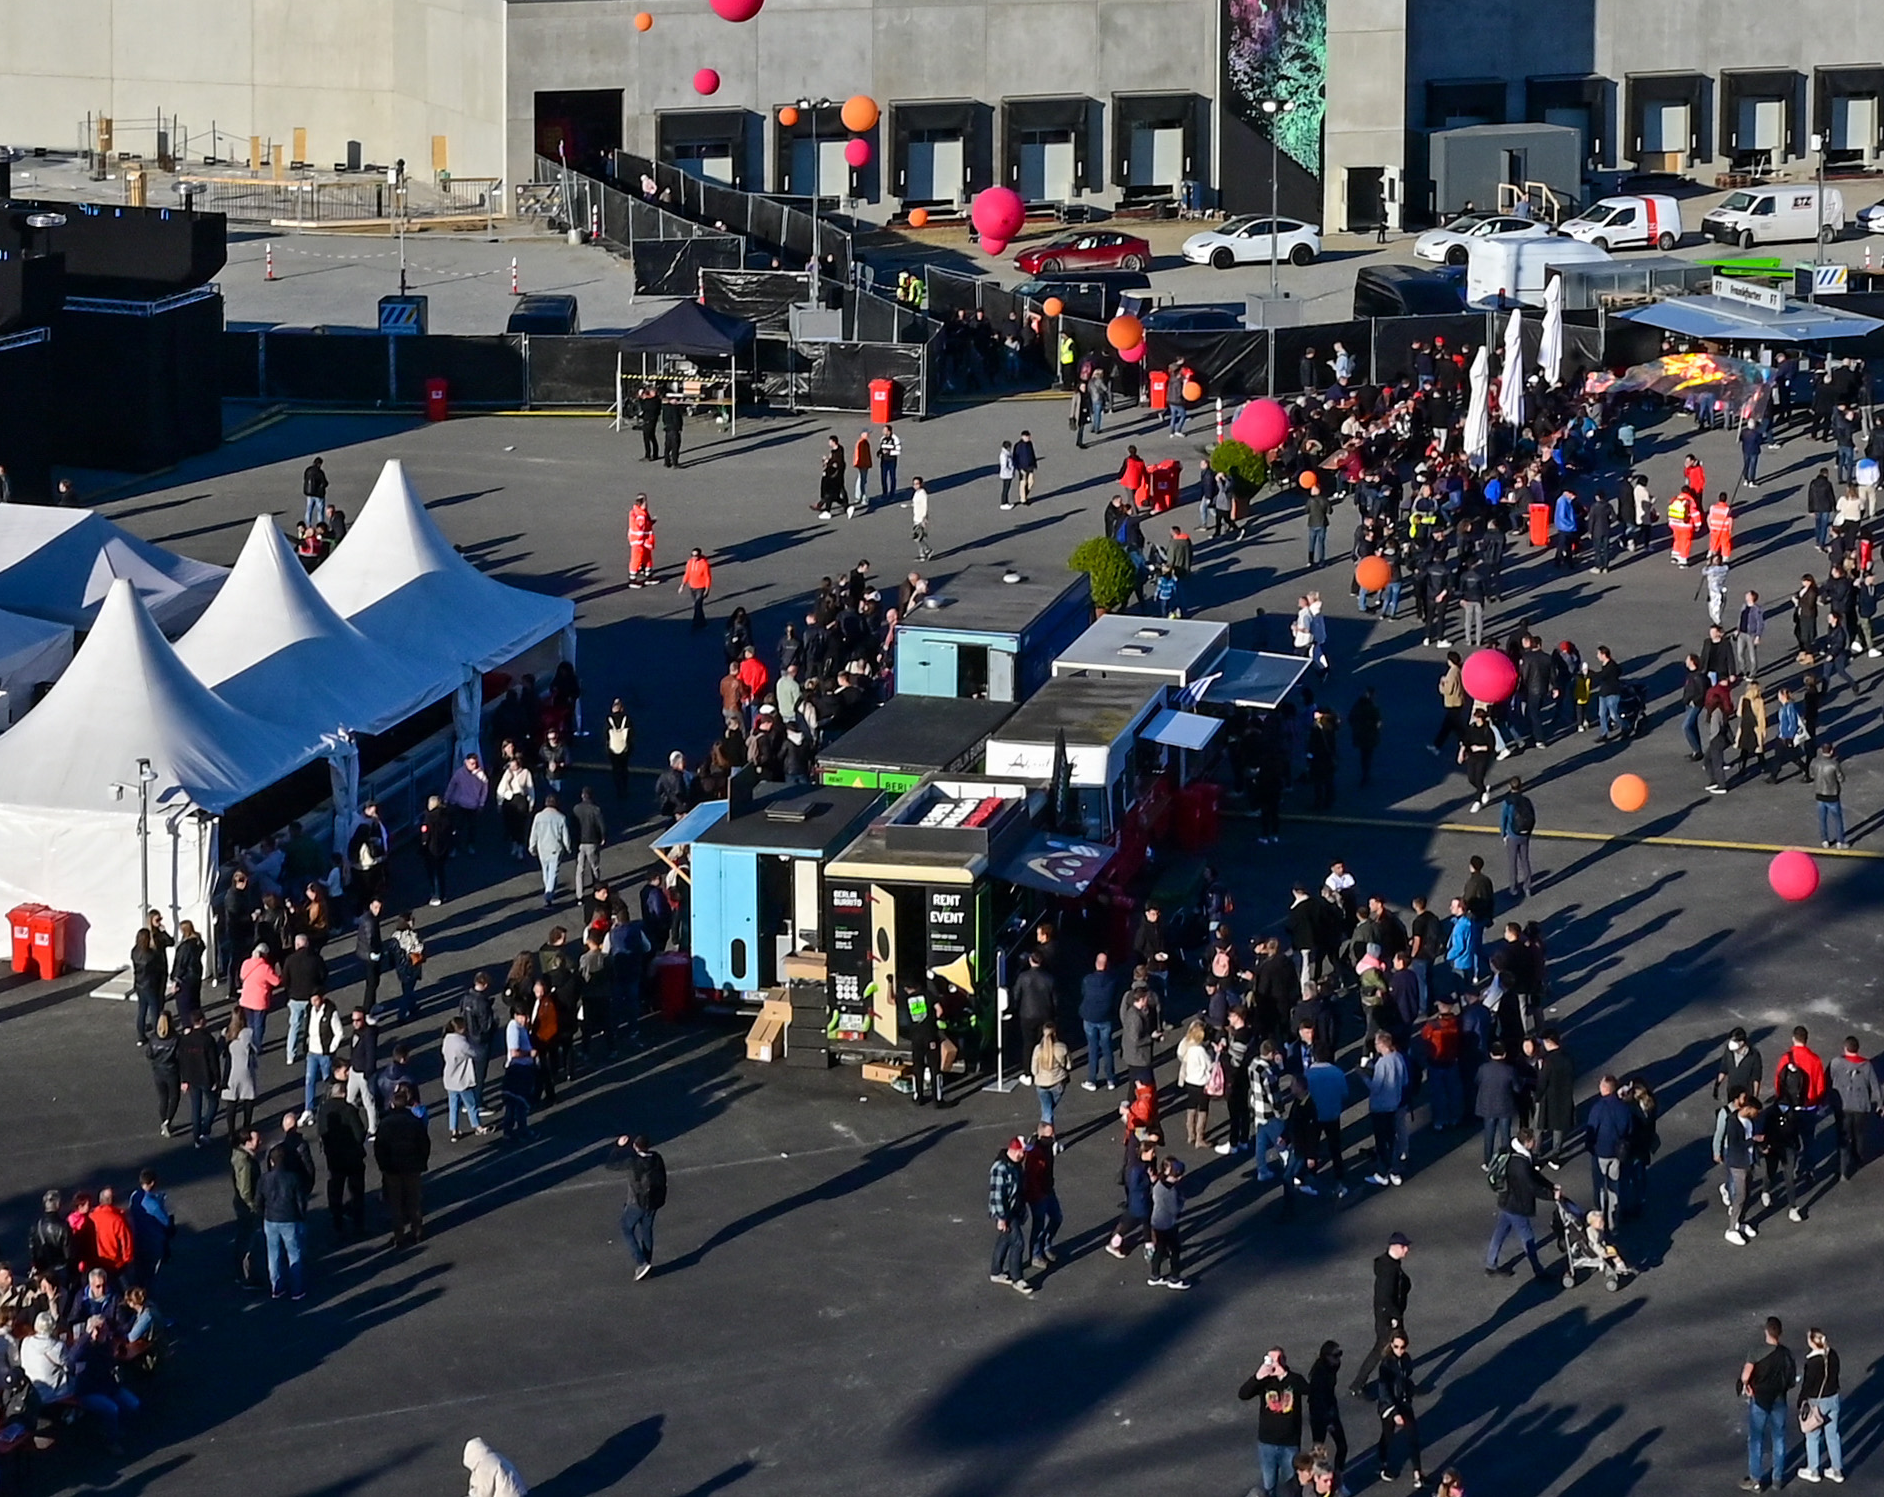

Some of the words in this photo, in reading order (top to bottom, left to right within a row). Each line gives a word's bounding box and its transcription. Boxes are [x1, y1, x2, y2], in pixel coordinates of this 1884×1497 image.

[833, 890, 858, 900] BERLIN
[932, 893, 962, 907] RENT
[930, 911, 965, 925] EVENT
